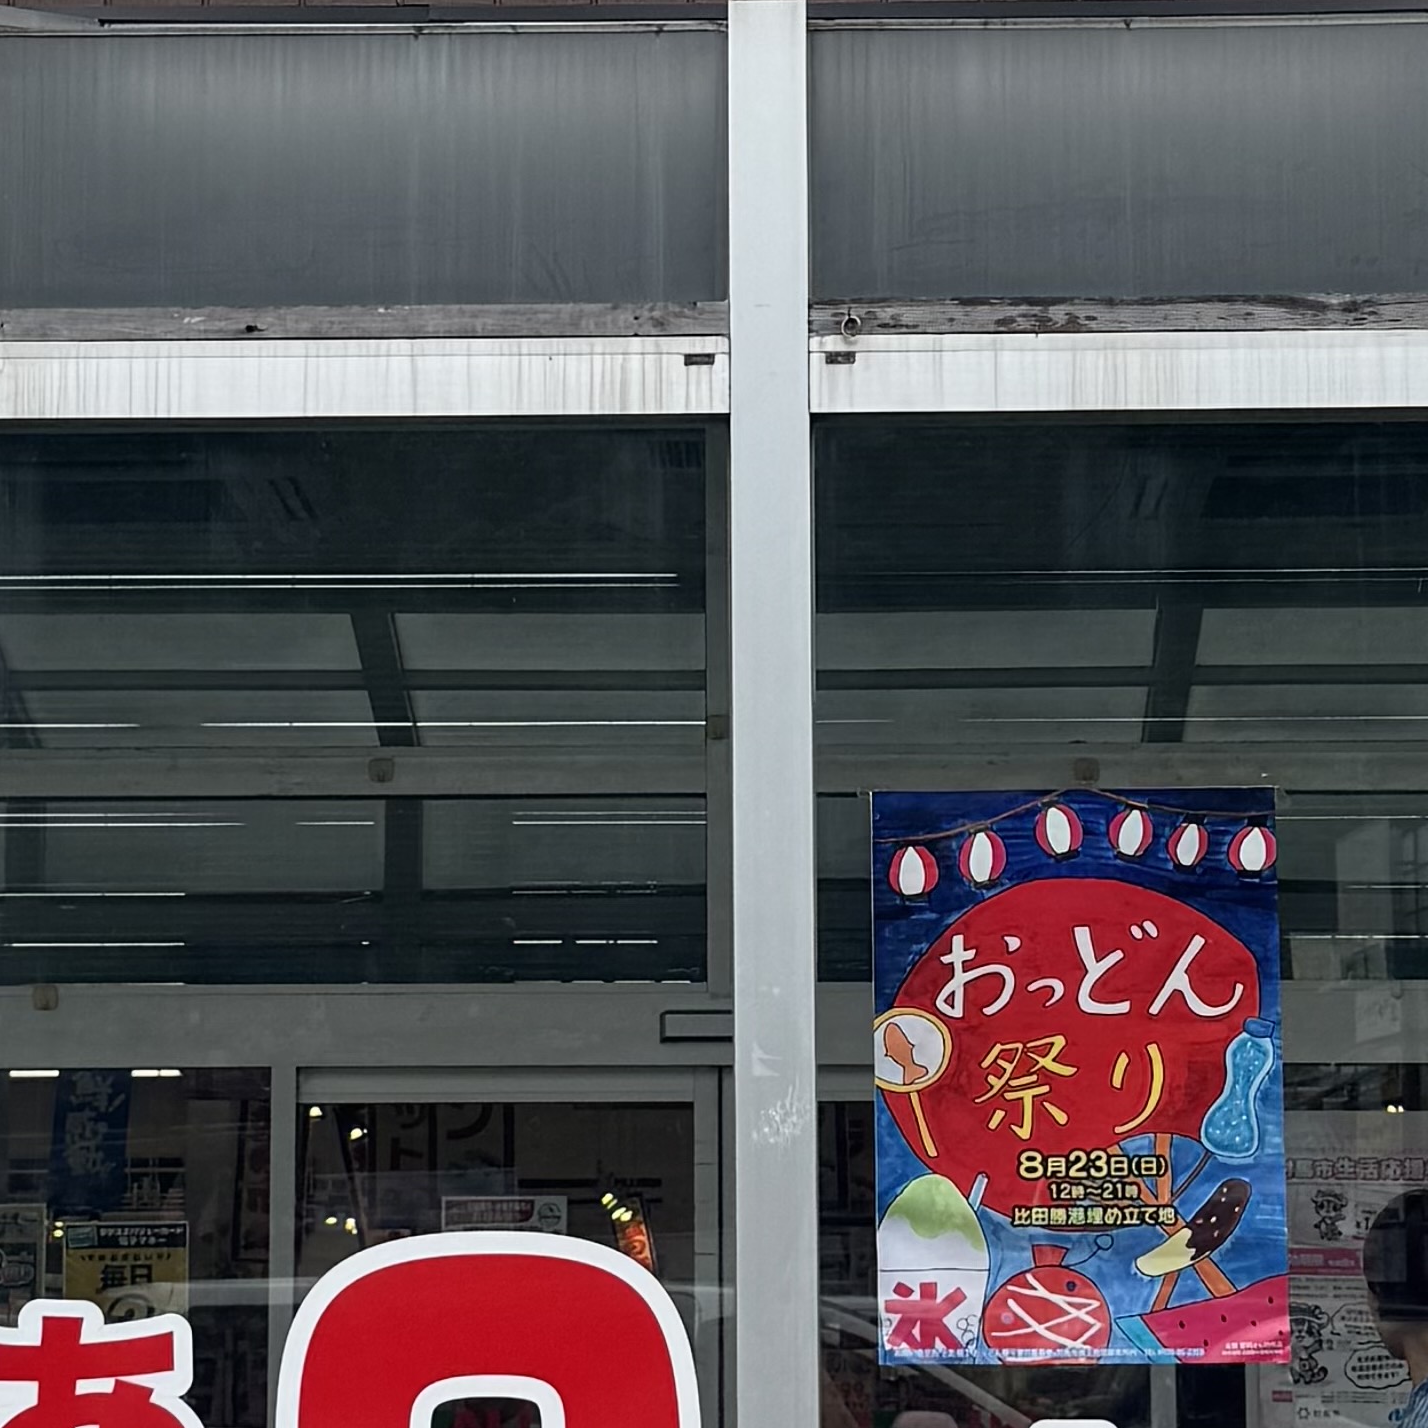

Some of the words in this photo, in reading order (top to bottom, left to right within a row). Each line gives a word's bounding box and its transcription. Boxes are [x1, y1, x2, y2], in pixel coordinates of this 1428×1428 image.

[935, 919, 1243, 1018] おっどん
[974, 1034, 1166, 1141] 祭り
[1018, 1149, 1168, 1179] 8月23日(日)
